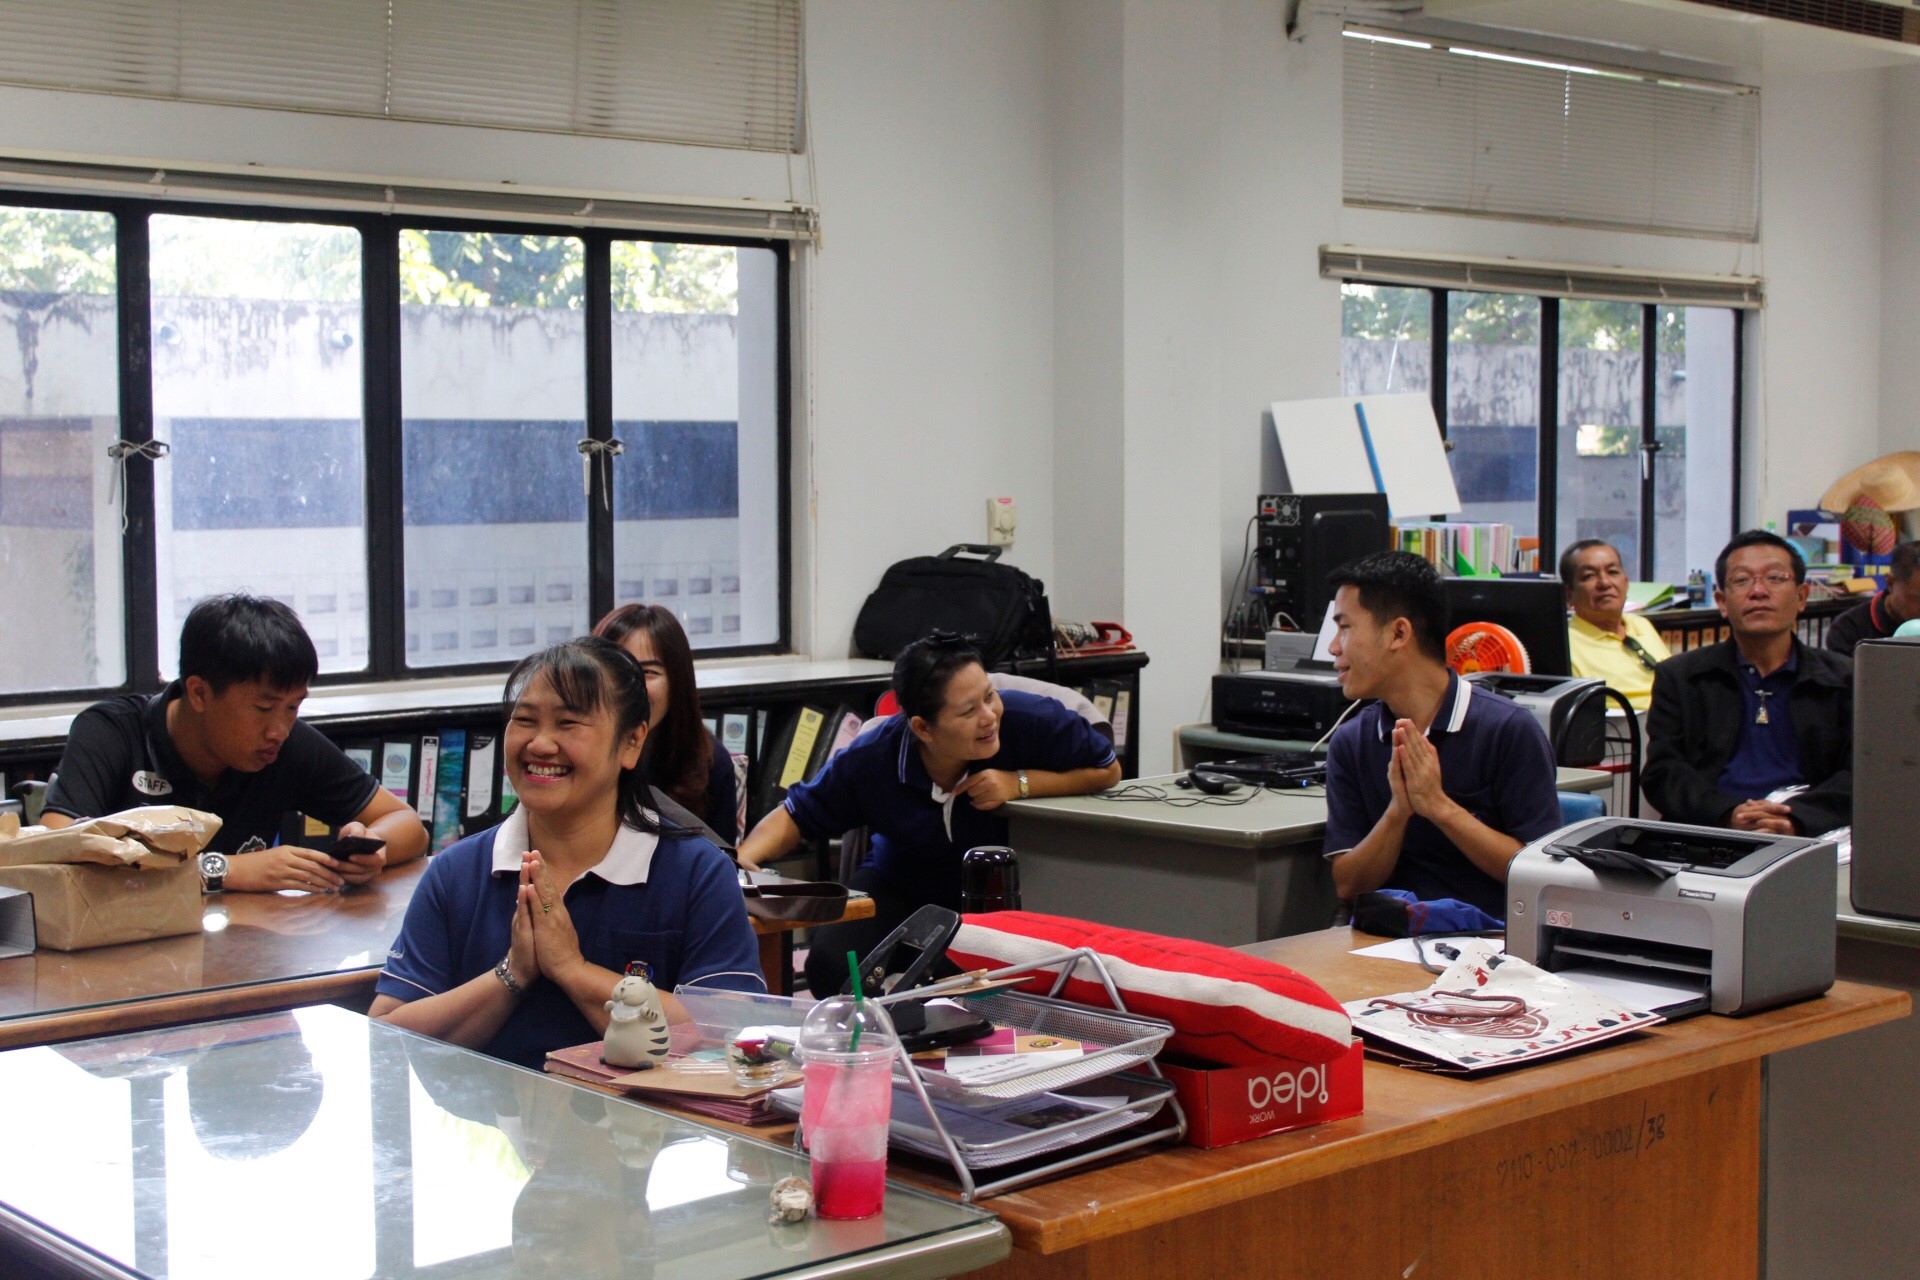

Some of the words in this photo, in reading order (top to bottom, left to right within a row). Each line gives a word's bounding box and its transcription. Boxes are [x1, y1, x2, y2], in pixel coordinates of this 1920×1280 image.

[138, 776, 167, 792] STAFF
[1248, 1063, 1329, 1114] idea
[1249, 1110, 1275, 1125] WORK
